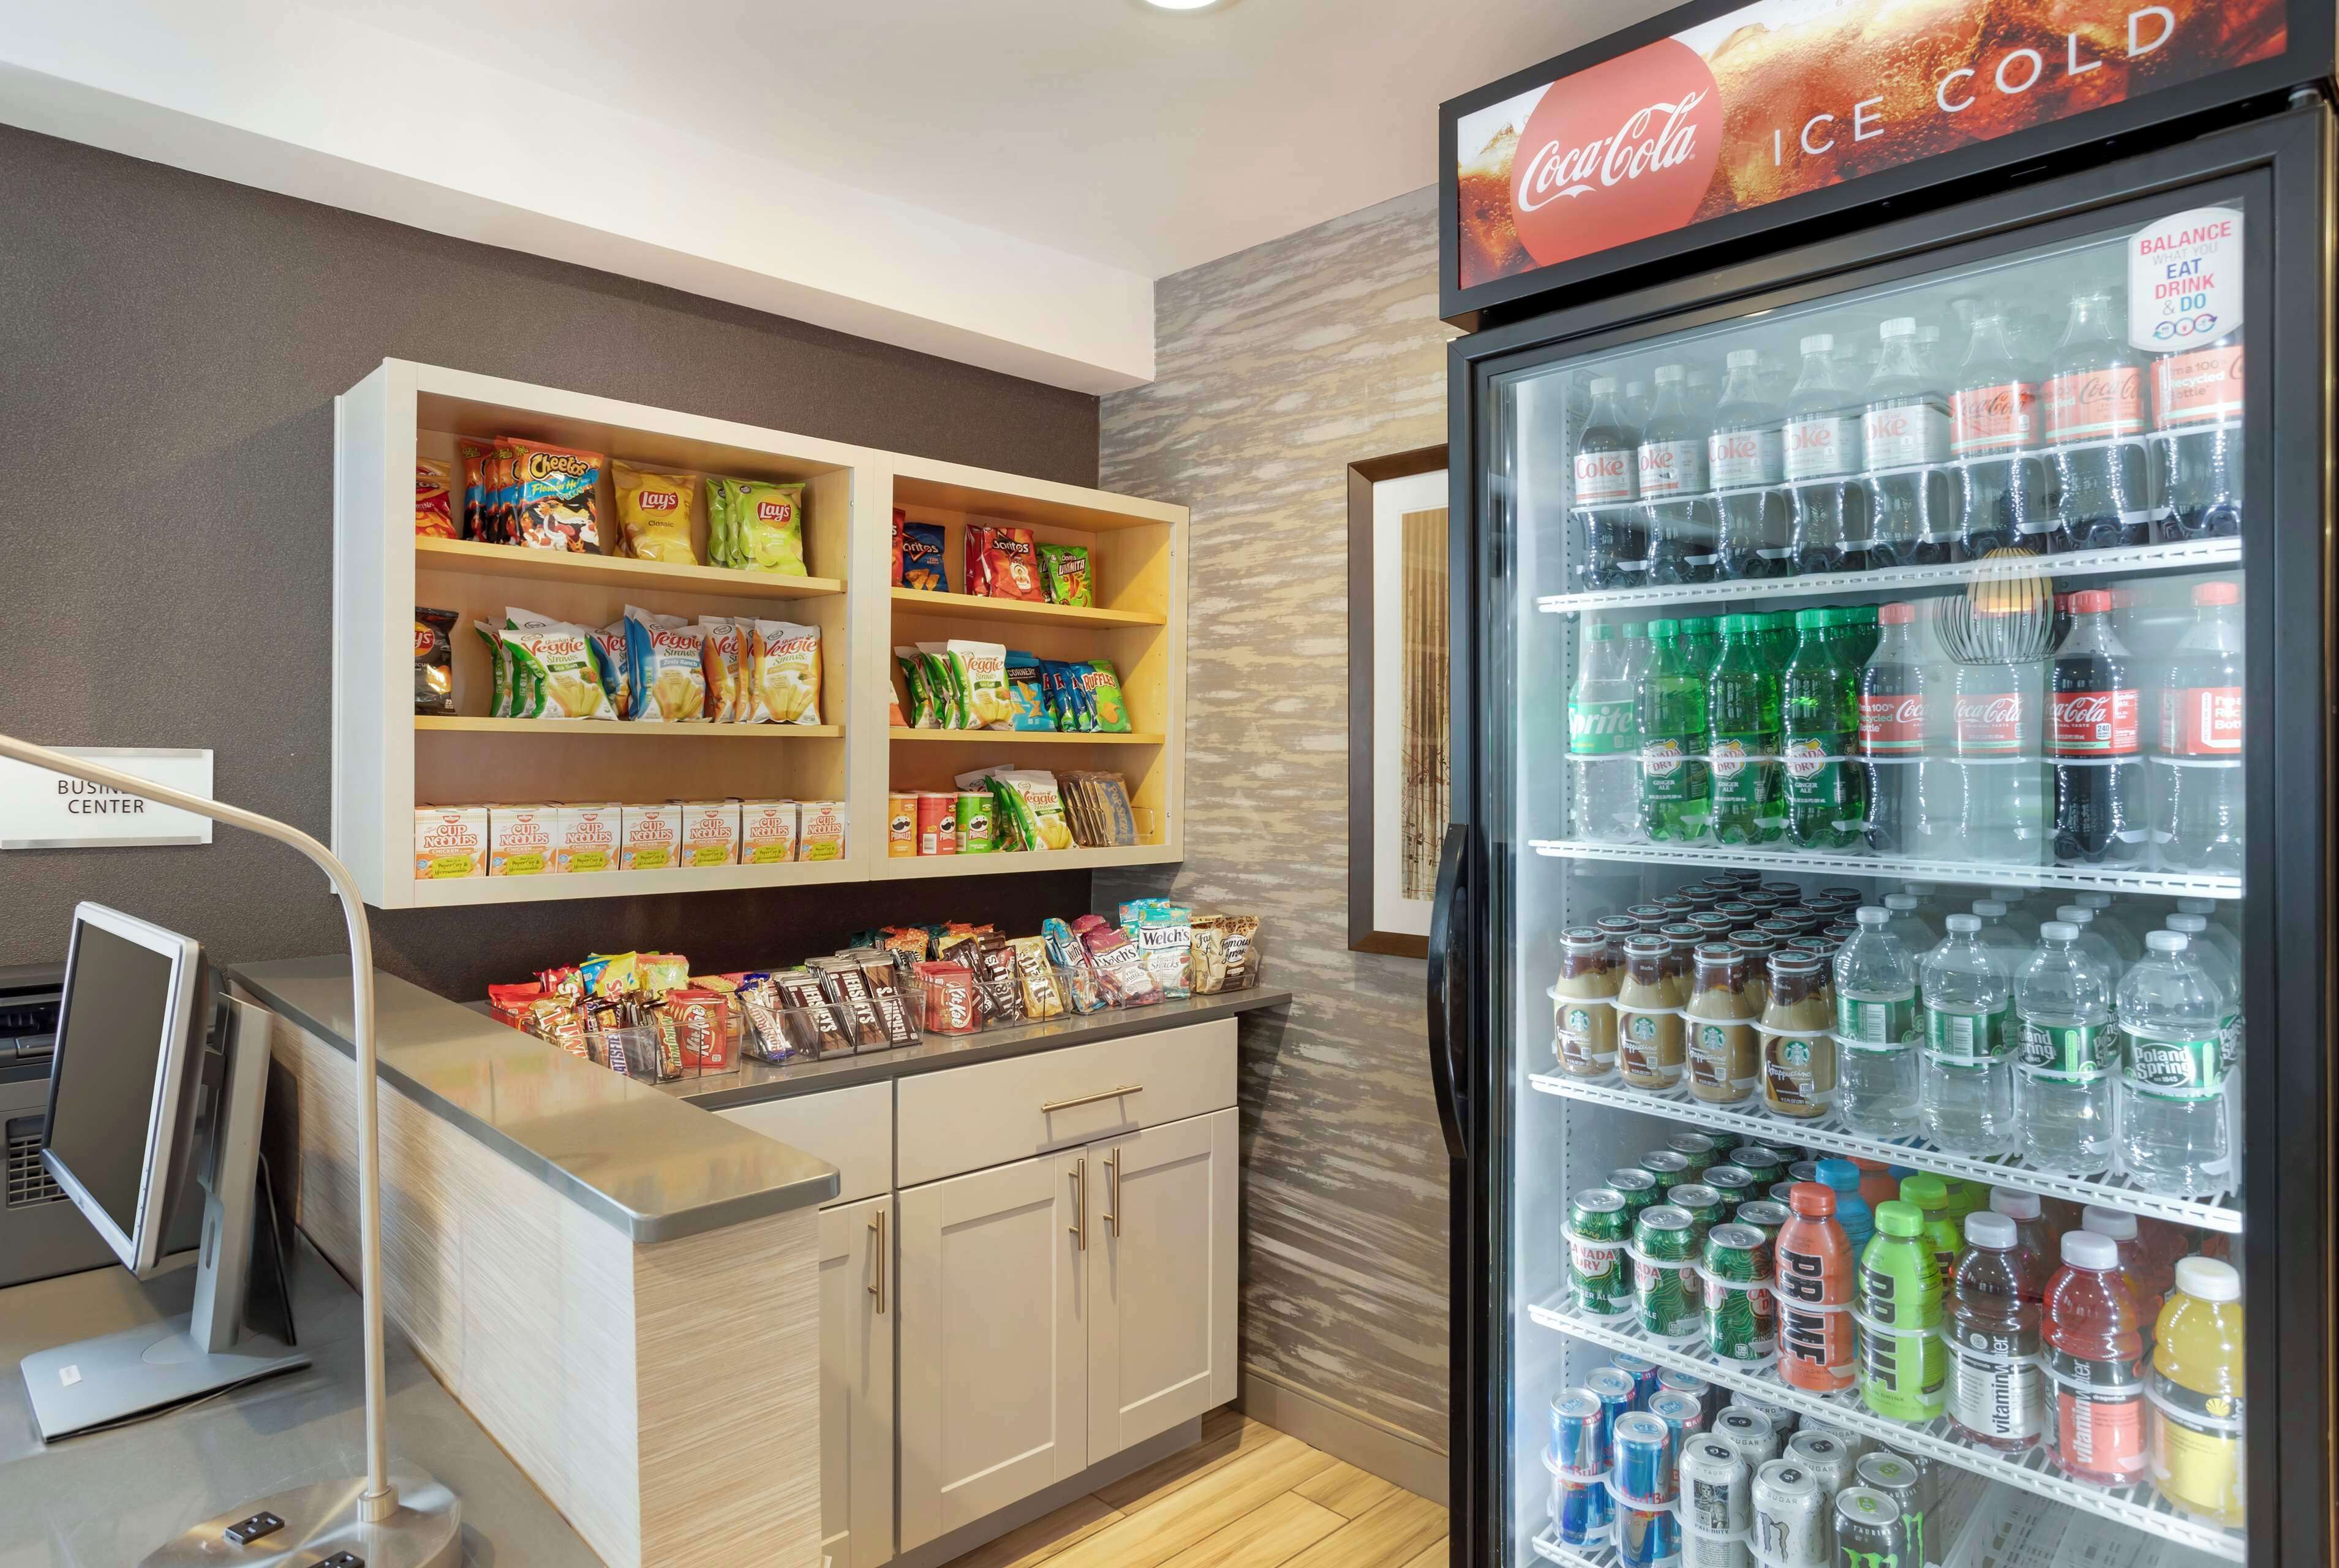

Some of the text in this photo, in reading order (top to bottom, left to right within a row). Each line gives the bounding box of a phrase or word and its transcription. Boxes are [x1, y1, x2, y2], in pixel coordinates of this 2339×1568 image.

[1774, 6, 2175, 166] ICE COLD
[1518, 86, 1710, 212] Coca-Cola
[2139, 221, 2232, 256] BALANCE
[2152, 241, 2219, 266] WHAT YOU
[2166, 258, 2202, 280] EAT
[2155, 274, 2215, 300] DRINK
[2163, 293, 2207, 315] & DO
[1709, 439, 1757, 463] Coke
[529, 452, 591, 480] Cheetos
[1576, 457, 1625, 480] Coke
[641, 491, 677, 510] Lay's
[759, 503, 791, 522] Lay's
[649, 630, 702, 649] Veggie
[521, 639, 586, 657] Veggie
[664, 648, 696, 657] Straws
[764, 639, 818, 657] Veggie
[547, 654, 578, 663] Straws
[962, 655, 1005, 673] Veggie
[1083, 671, 1116, 691] RUFFLES
[1954, 697, 2025, 723] Coca-Cola
[1652, 761, 1673, 772] DRY
[1717, 762, 1736, 773] DRY
[1795, 762, 1815, 773] DRY
[68, 799, 145, 813] CENTER
[639, 820, 665, 831] CUP
[700, 818, 725, 829] CUP
[758, 818, 782, 827] CUP
[816, 815, 837, 826] CUP
[437, 824, 467, 837] CUP
[511, 823, 540, 835] CUP
[576, 822, 605, 834] CUP
[690, 827, 731, 840] NOODLES
[750, 826, 789, 838] NOODLES
[808, 823, 842, 835] NOODLES
[424, 835, 478, 848] NOODLES
[500, 833, 549, 846] NOODLES
[565, 832, 612, 845] NOODLES
[630, 829, 673, 842] NOODLES
[891, 831, 911, 841] PRINGLES
[969, 830, 988, 840] PRINGLES
[1142, 930, 1190, 946] Welch's
[1219, 937, 1251, 956] Famous
[842, 971, 876, 1024] HERSHEY'S
[801, 985, 838, 1033] HERSHEY'S
[2134, 1046, 2190, 1061] Poland
[2135, 1058, 2195, 1079] Spring
[2093, 1393, 2126, 1402] dragonfruit
[1730, 1437, 1760, 1446] SUGAR
[1767, 1494, 1798, 1504] SUGAR
[1853, 1525, 1891, 1535] TAURINE
